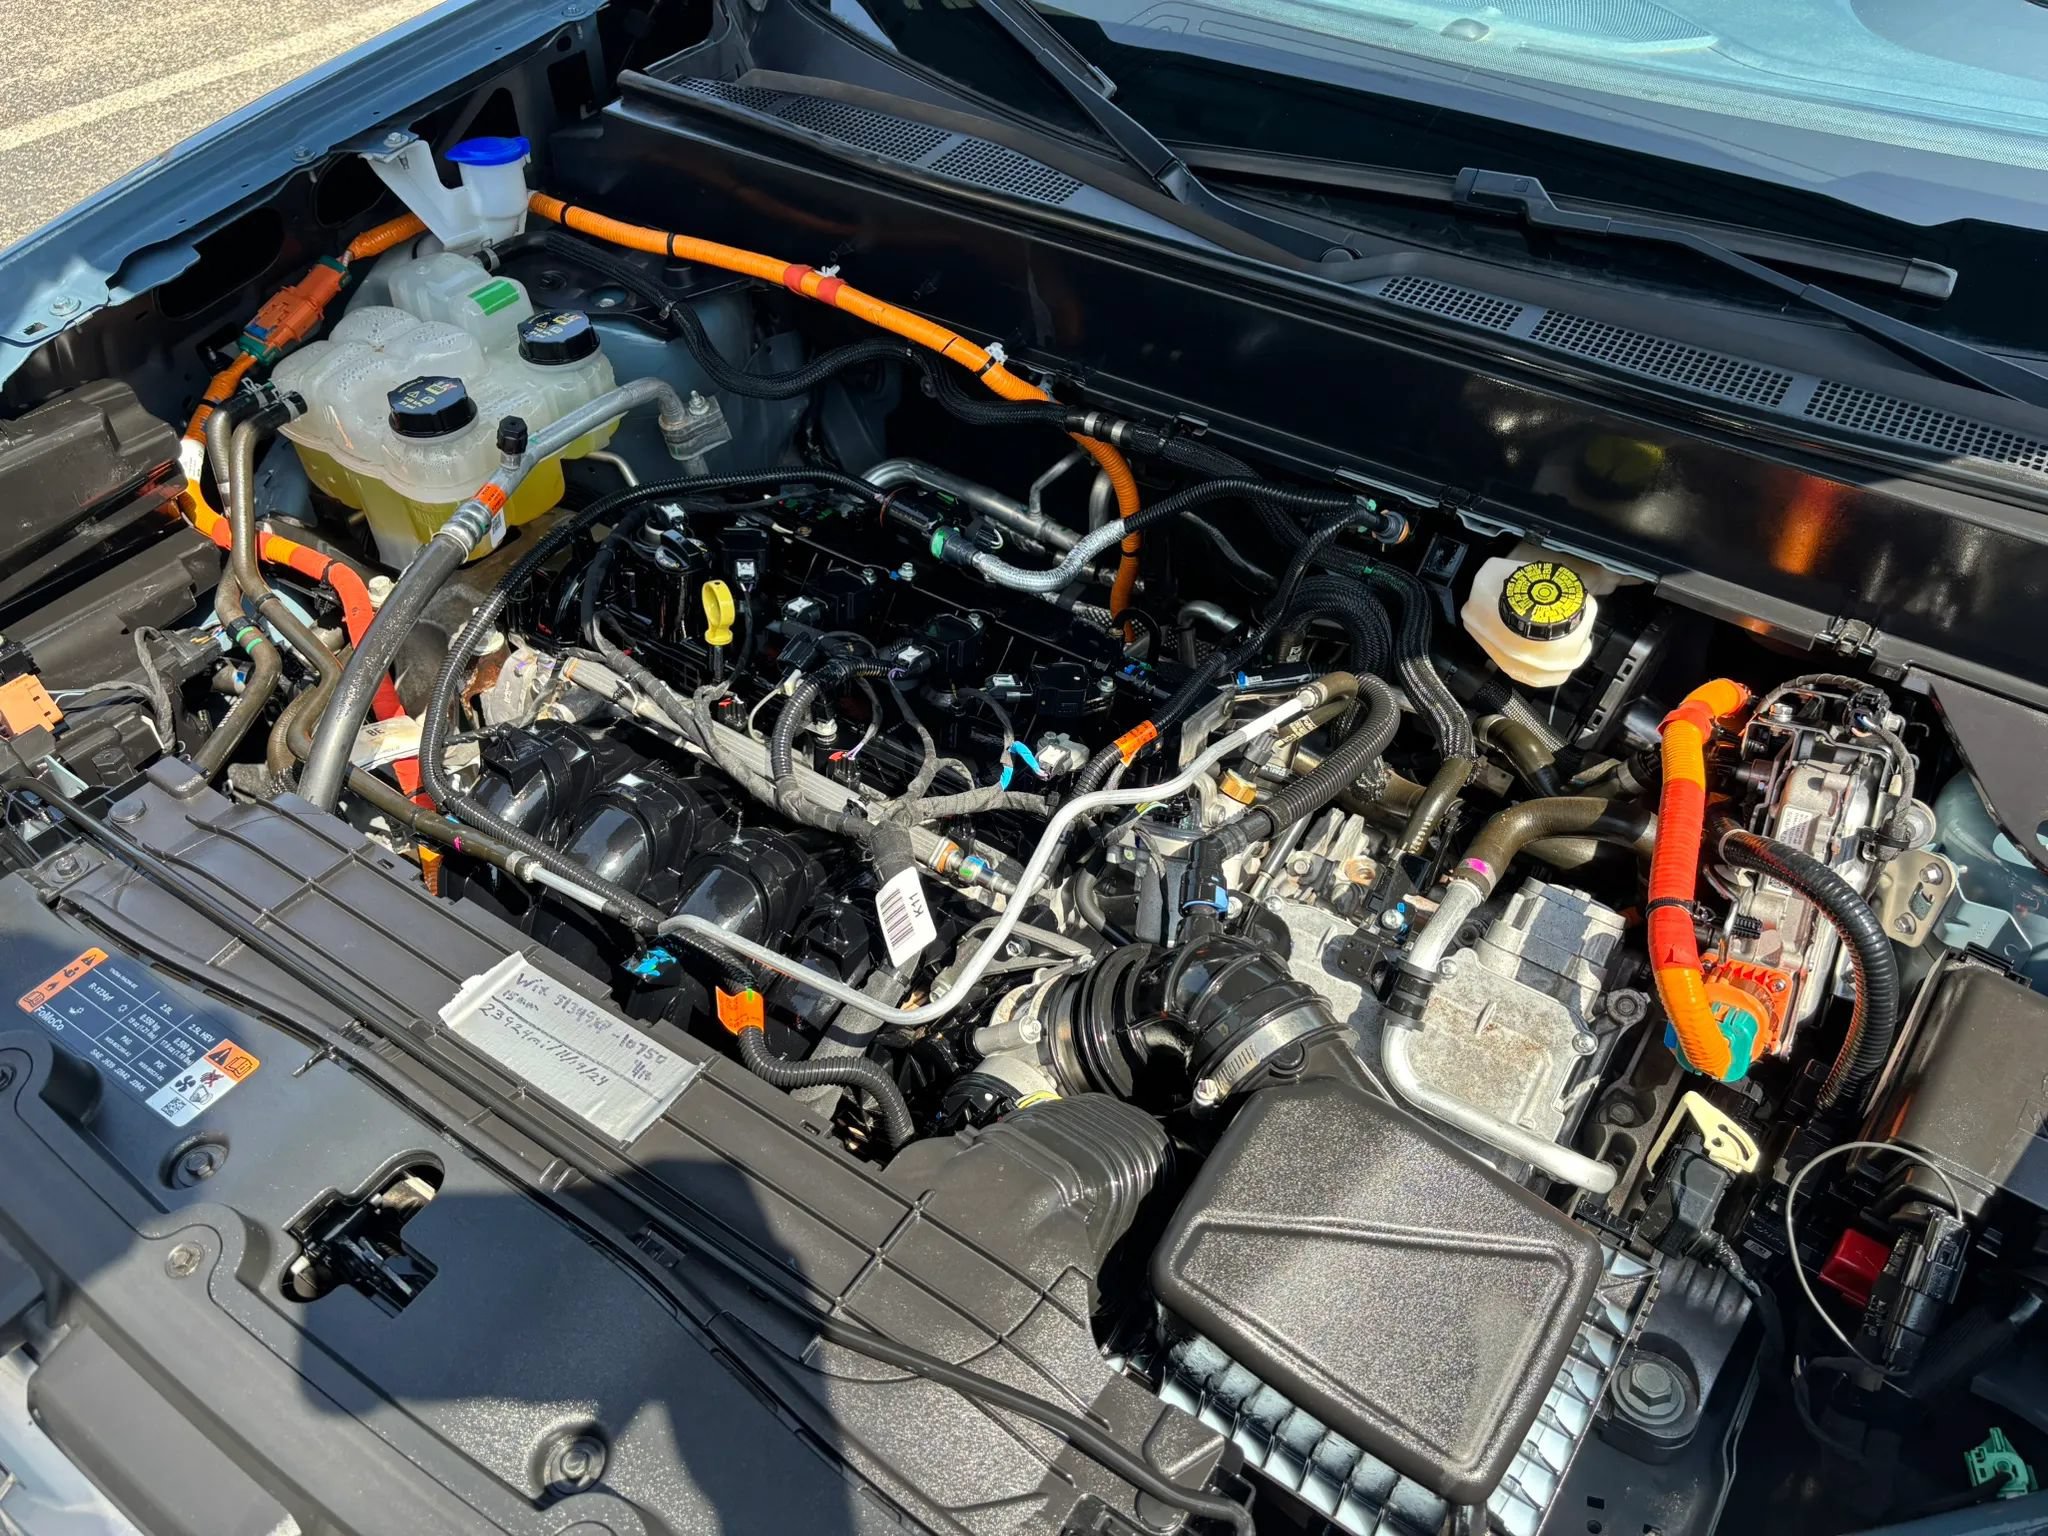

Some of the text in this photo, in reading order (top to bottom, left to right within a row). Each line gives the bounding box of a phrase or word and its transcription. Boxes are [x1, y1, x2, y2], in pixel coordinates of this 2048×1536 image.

[909, 892, 924, 918] K11
[35, 1005, 64, 1031] FoMoCo
[199, 1031, 216, 1043] HEV
[89, 1048, 104, 1060] SAE
